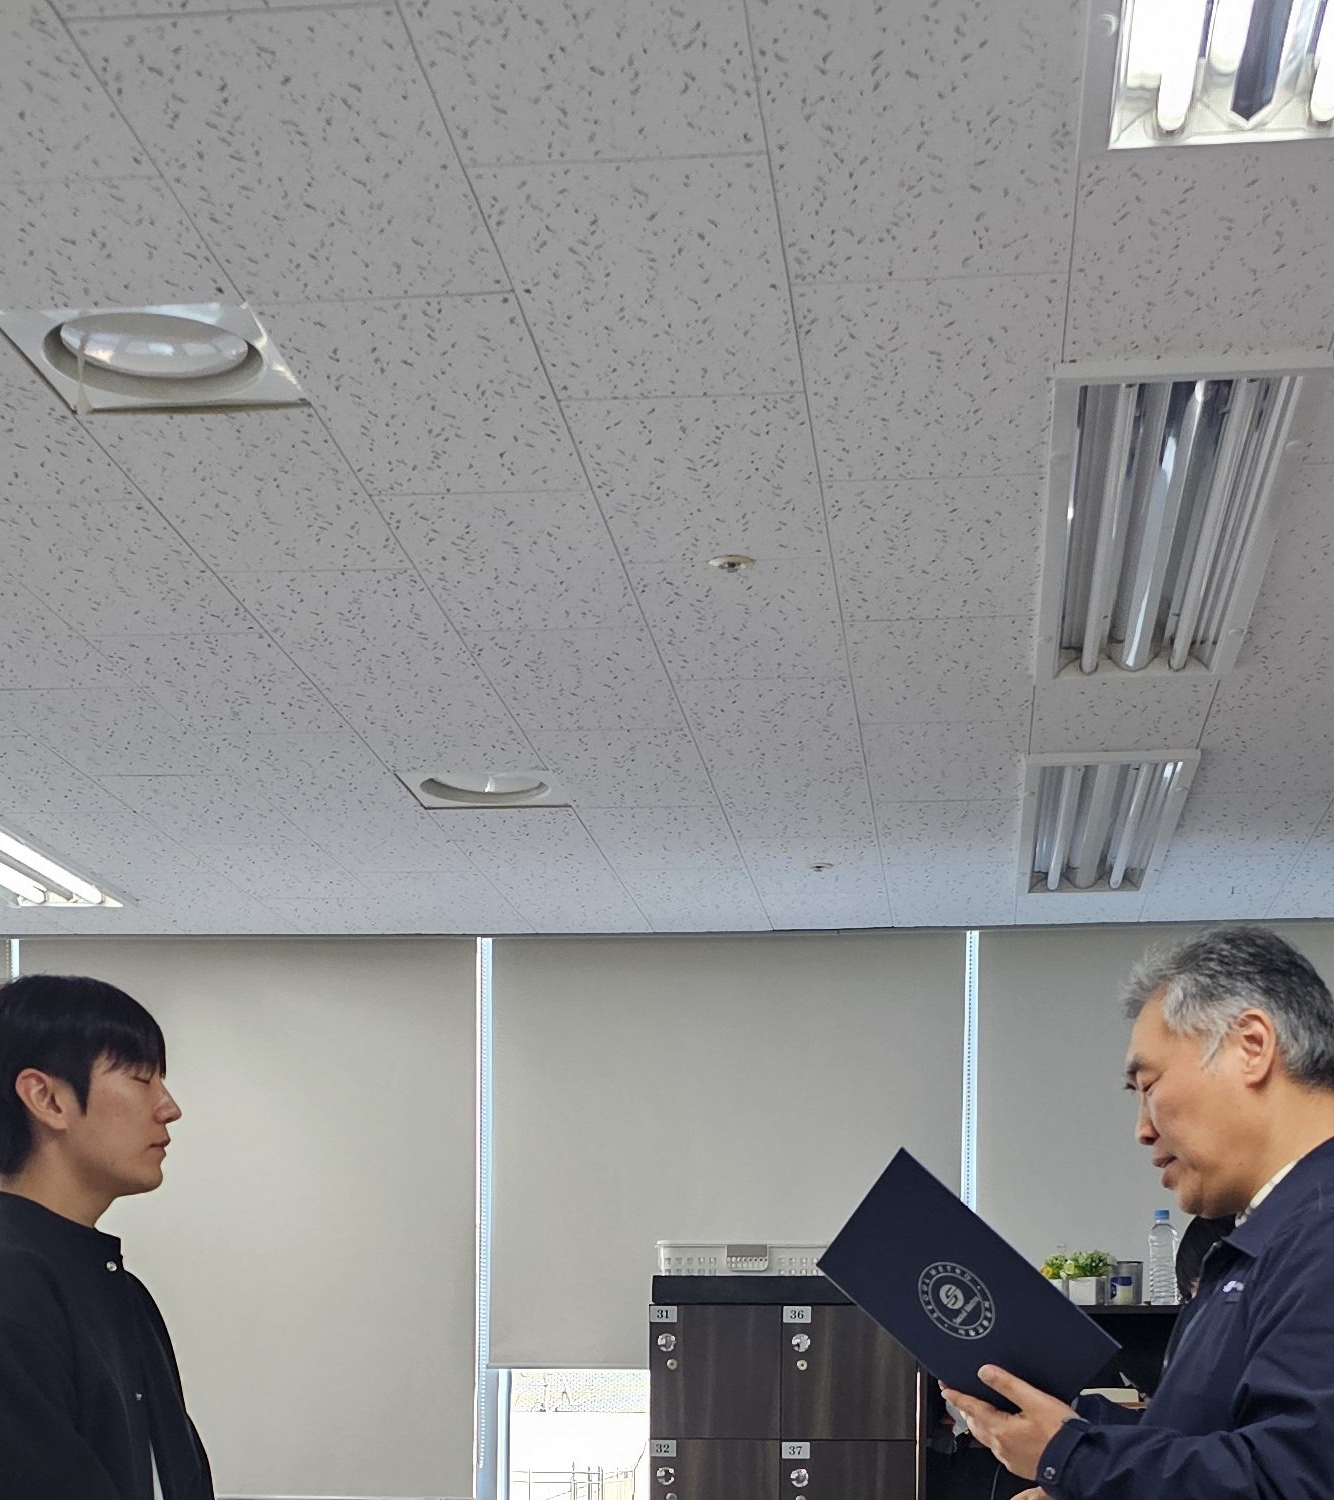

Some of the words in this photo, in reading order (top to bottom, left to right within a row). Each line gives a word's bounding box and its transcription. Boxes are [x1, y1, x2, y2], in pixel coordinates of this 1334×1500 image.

[656, 1309, 670, 1319] 31
[789, 1310, 805, 1320] 36
[655, 1444, 670, 1454] 32
[788, 1446, 803, 1456] 37
